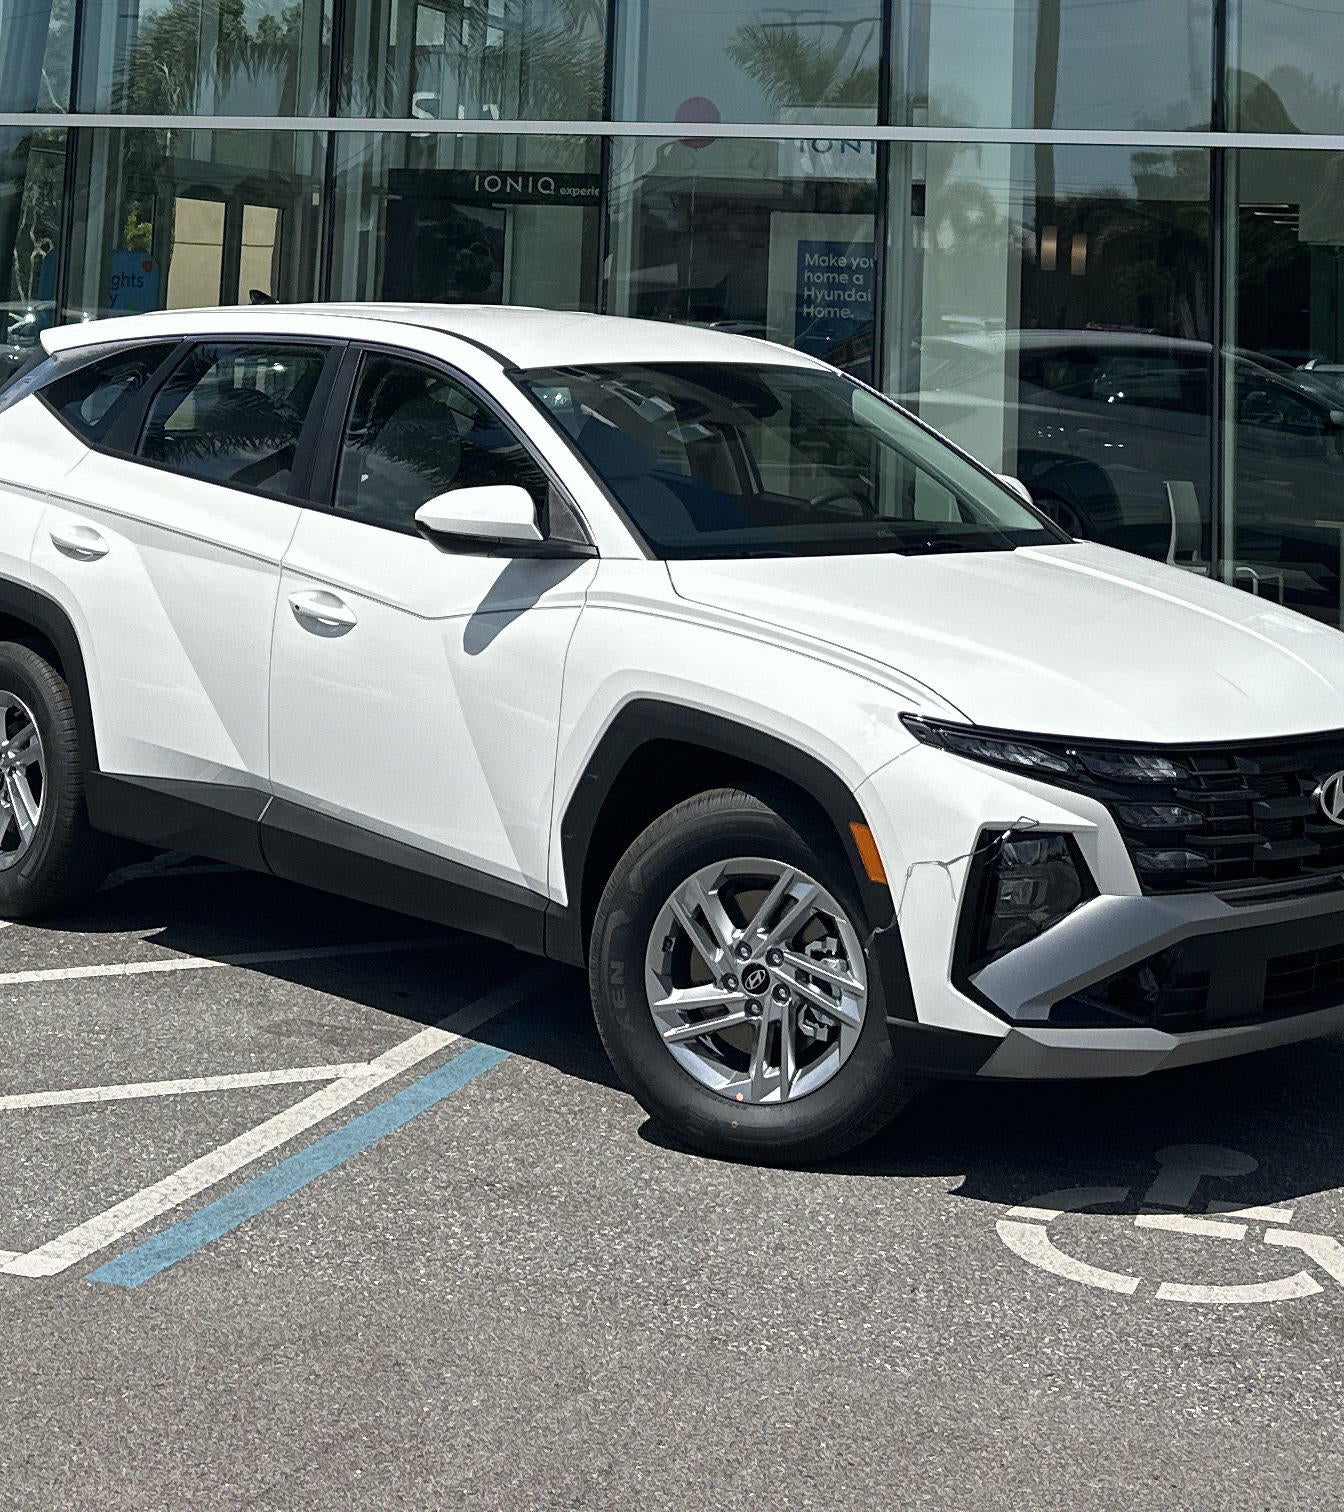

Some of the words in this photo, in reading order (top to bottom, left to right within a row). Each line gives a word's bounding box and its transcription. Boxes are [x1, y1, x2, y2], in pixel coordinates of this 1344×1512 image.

[799, 138, 875, 155] IONI
[474, 175, 555, 194] IONIQ
[804, 252, 847, 267] Make
[804, 269, 849, 284] home
[852, 274, 864, 285] a
[803, 285, 872, 303] Hyundai
[802, 303, 855, 319] Home.
